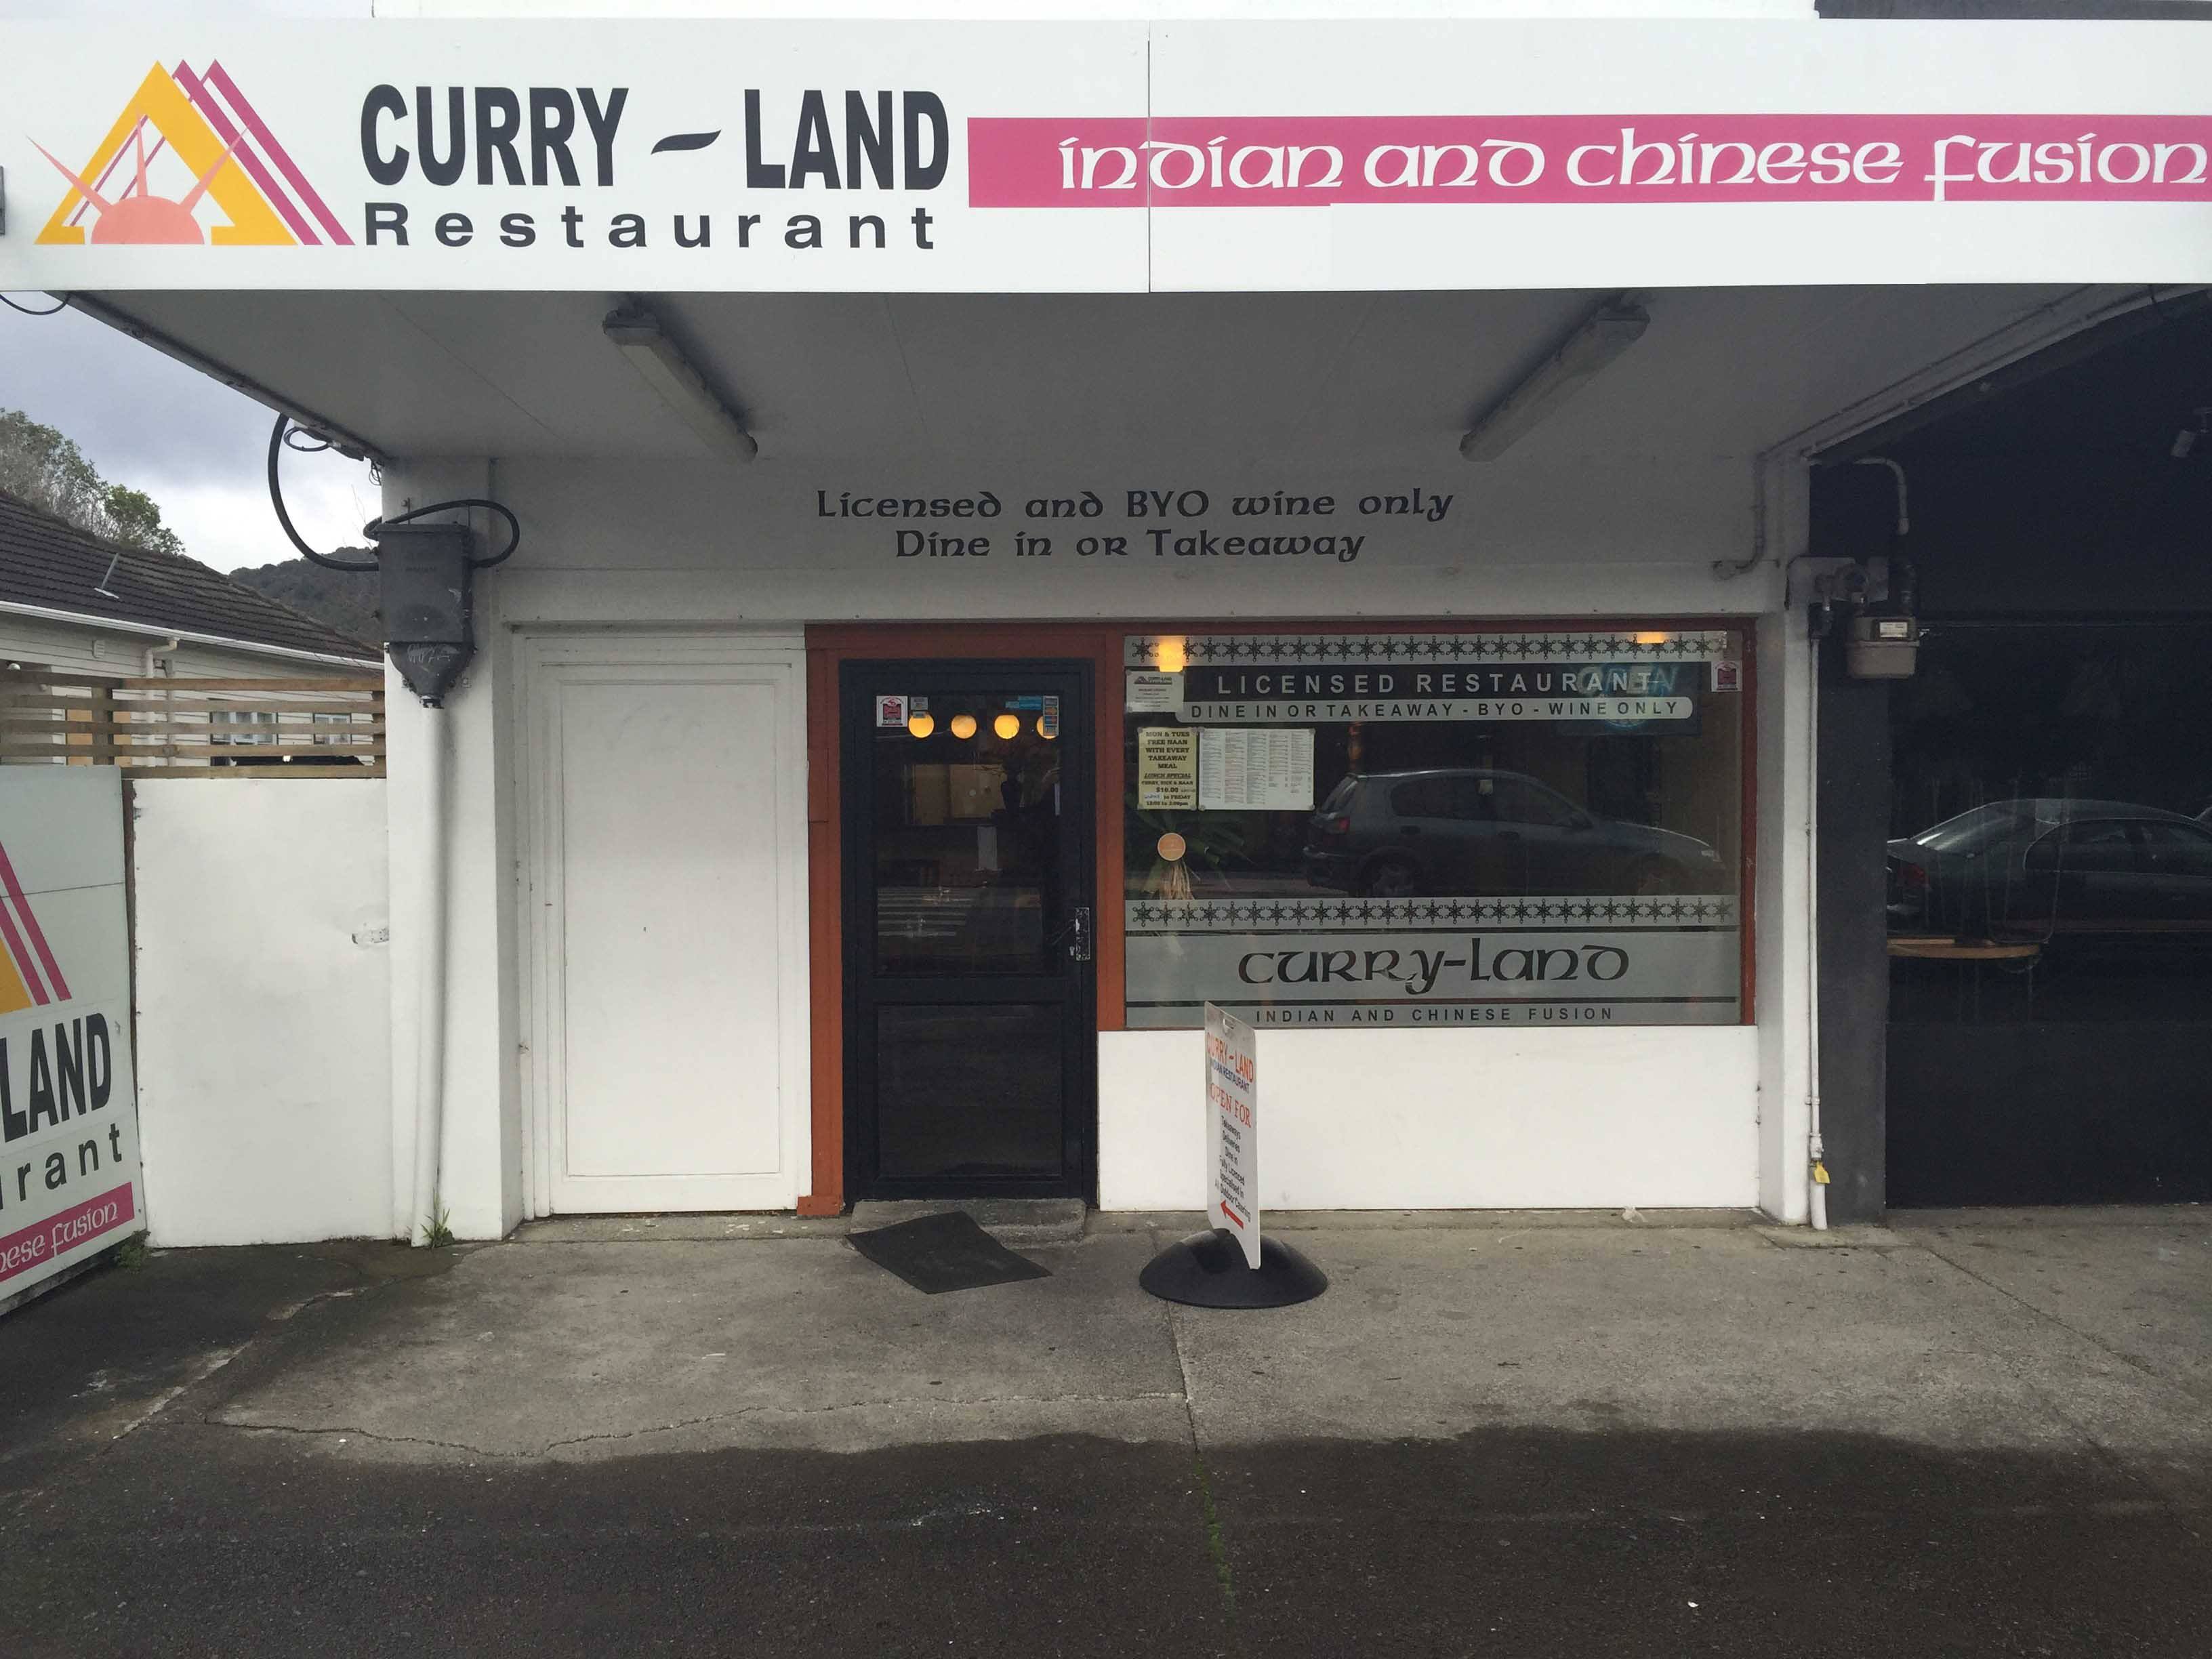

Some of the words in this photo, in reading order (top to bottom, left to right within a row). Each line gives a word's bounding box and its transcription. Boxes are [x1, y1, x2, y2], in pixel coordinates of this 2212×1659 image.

[361, 84, 629, 186] CURRY
[744, 89, 949, 190] LAND
[1364, 138, 1545, 188] and
[1924, 132, 2208, 202] fusion
[365, 201, 934, 248] Restaurant
[817, 490, 1002, 518] Licensed
[1025, 491, 1103, 518] and
[1127, 490, 1209, 517] BYO
[1231, 491, 1336, 516] wine
[1359, 488, 1454, 522] only
[895, 530, 990, 557] Dine
[1015, 531, 1052, 556] in
[1147, 529, 1366, 562] Takeaway
[1218, 674, 1394, 693] LICENSED
[1416, 673, 1652, 693] RESTAURANT
[1191, 705, 1245, 718] DINE
[1256, 705, 1277, 718] IN
[1288, 704, 1316, 717] OR
[1327, 703, 1452, 717] TAKEAWAY
[1479, 703, 1523, 716] BYO
[1549, 702, 1607, 715] WINE
[1617, 701, 1677, 715] ONLY
[1256, 1010, 1334, 1022] INDIAN
[1351, 1009, 1394, 1021] AND
[1412, 1008, 1511, 1021] CHINESE
[1529, 1008, 1611, 1020] FUSION
[0, 1012, 111, 1143] LAND
[1235, 1049, 1254, 1083] LAND
[1210, 1082, 1232, 1113] OPEN
[1235, 1099, 1251, 1128] FOR
[51, 1202, 117, 1257] fusion
